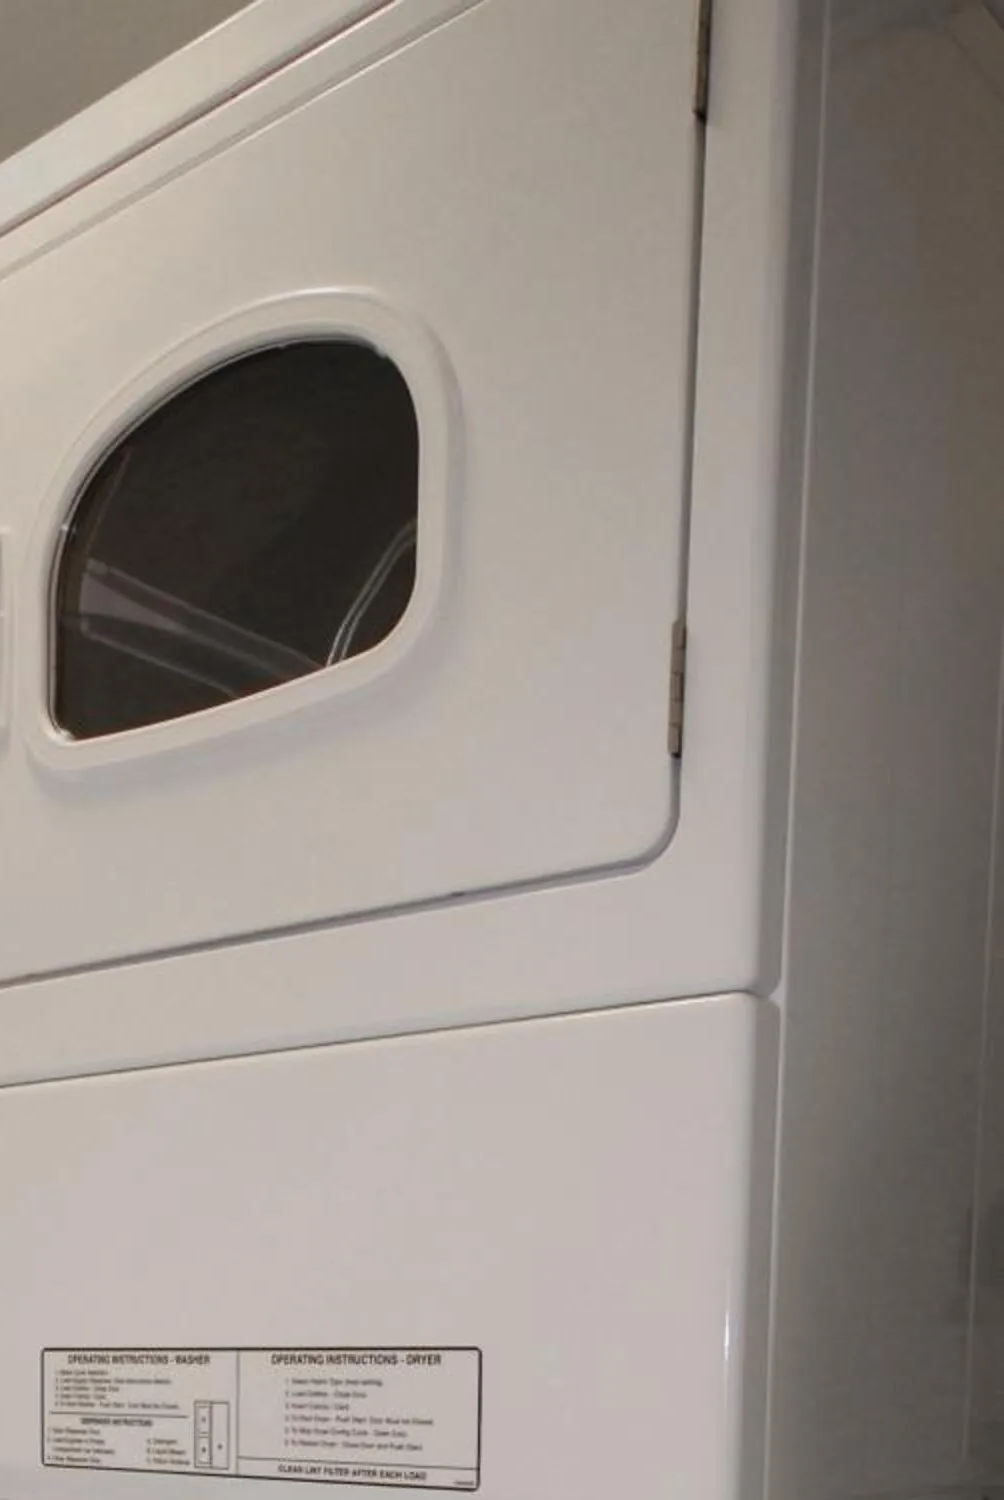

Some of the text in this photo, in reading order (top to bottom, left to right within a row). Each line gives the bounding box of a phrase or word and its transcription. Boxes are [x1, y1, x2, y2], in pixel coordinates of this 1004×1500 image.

[176, 1354, 211, 1365] WASHER
[271, 1353, 325, 1365] OPERATING
[326, 1353, 398, 1365] INSTRUCTIONS
[406, 1353, 442, 1366] DRYER
[404, 1470, 428, 1481] LOAD
